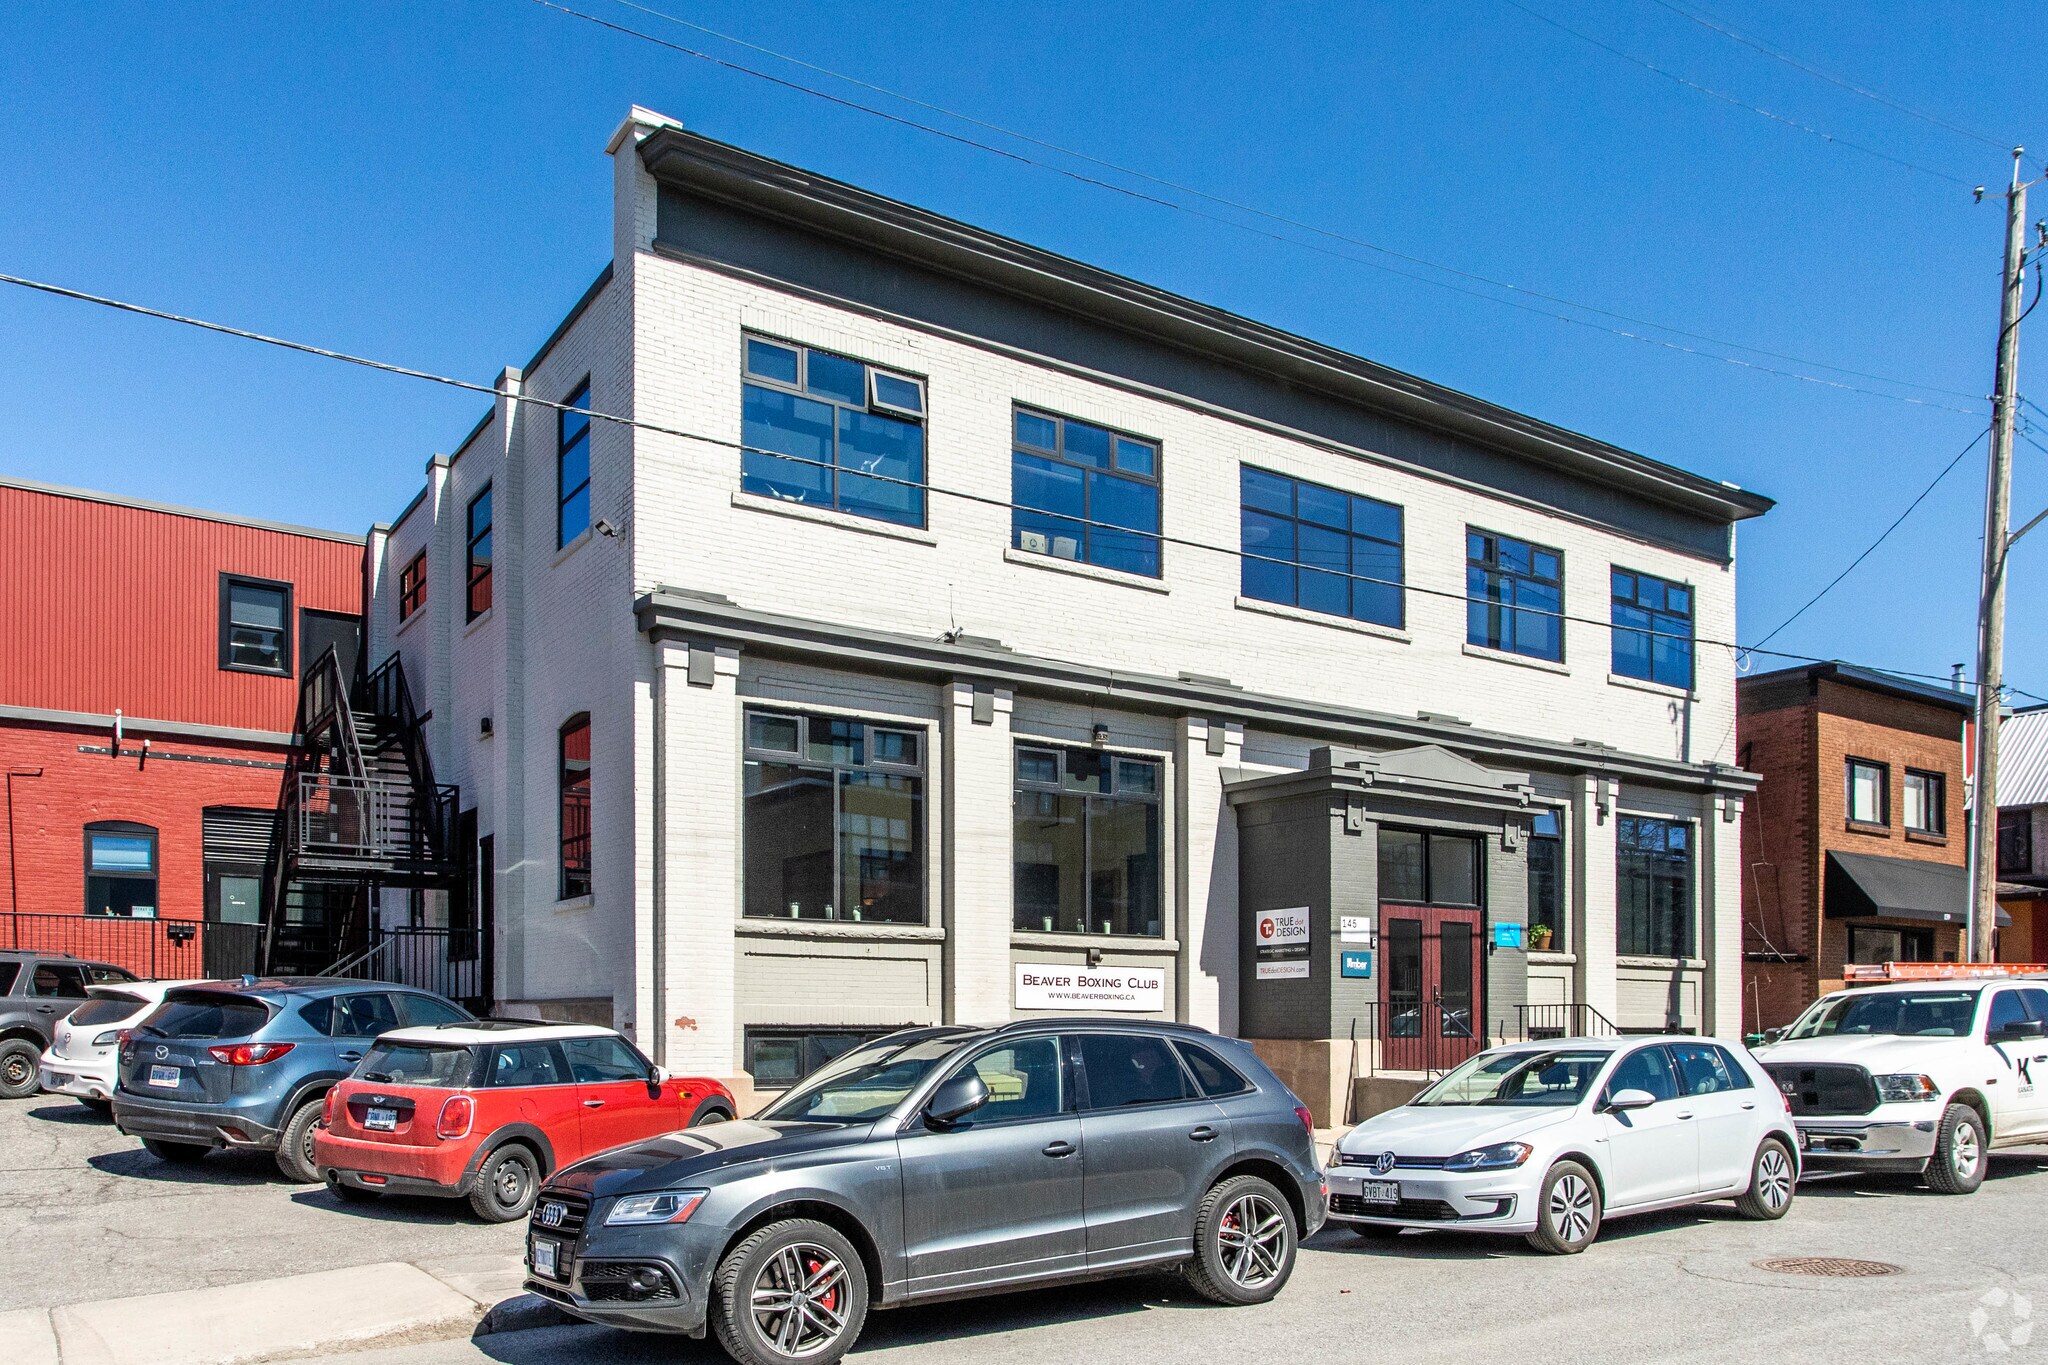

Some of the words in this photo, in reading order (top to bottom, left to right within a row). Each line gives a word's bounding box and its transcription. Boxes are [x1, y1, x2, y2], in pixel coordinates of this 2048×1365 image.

[1275, 916, 1294, 927] TRUE
[1342, 919, 1357, 928] 145
[1276, 926, 1306, 937] DESIGN
[1023, 974, 1071, 987] BEAVER
[1078, 975, 1122, 988] BOXING
[1127, 977, 1159, 989] CLUB
[1047, 992, 1136, 1001] WWW.BEAVERBOXING.CA
[1364, 1186, 1381, 1198] GVBT
[1385, 1186, 1398, 1199] 419
